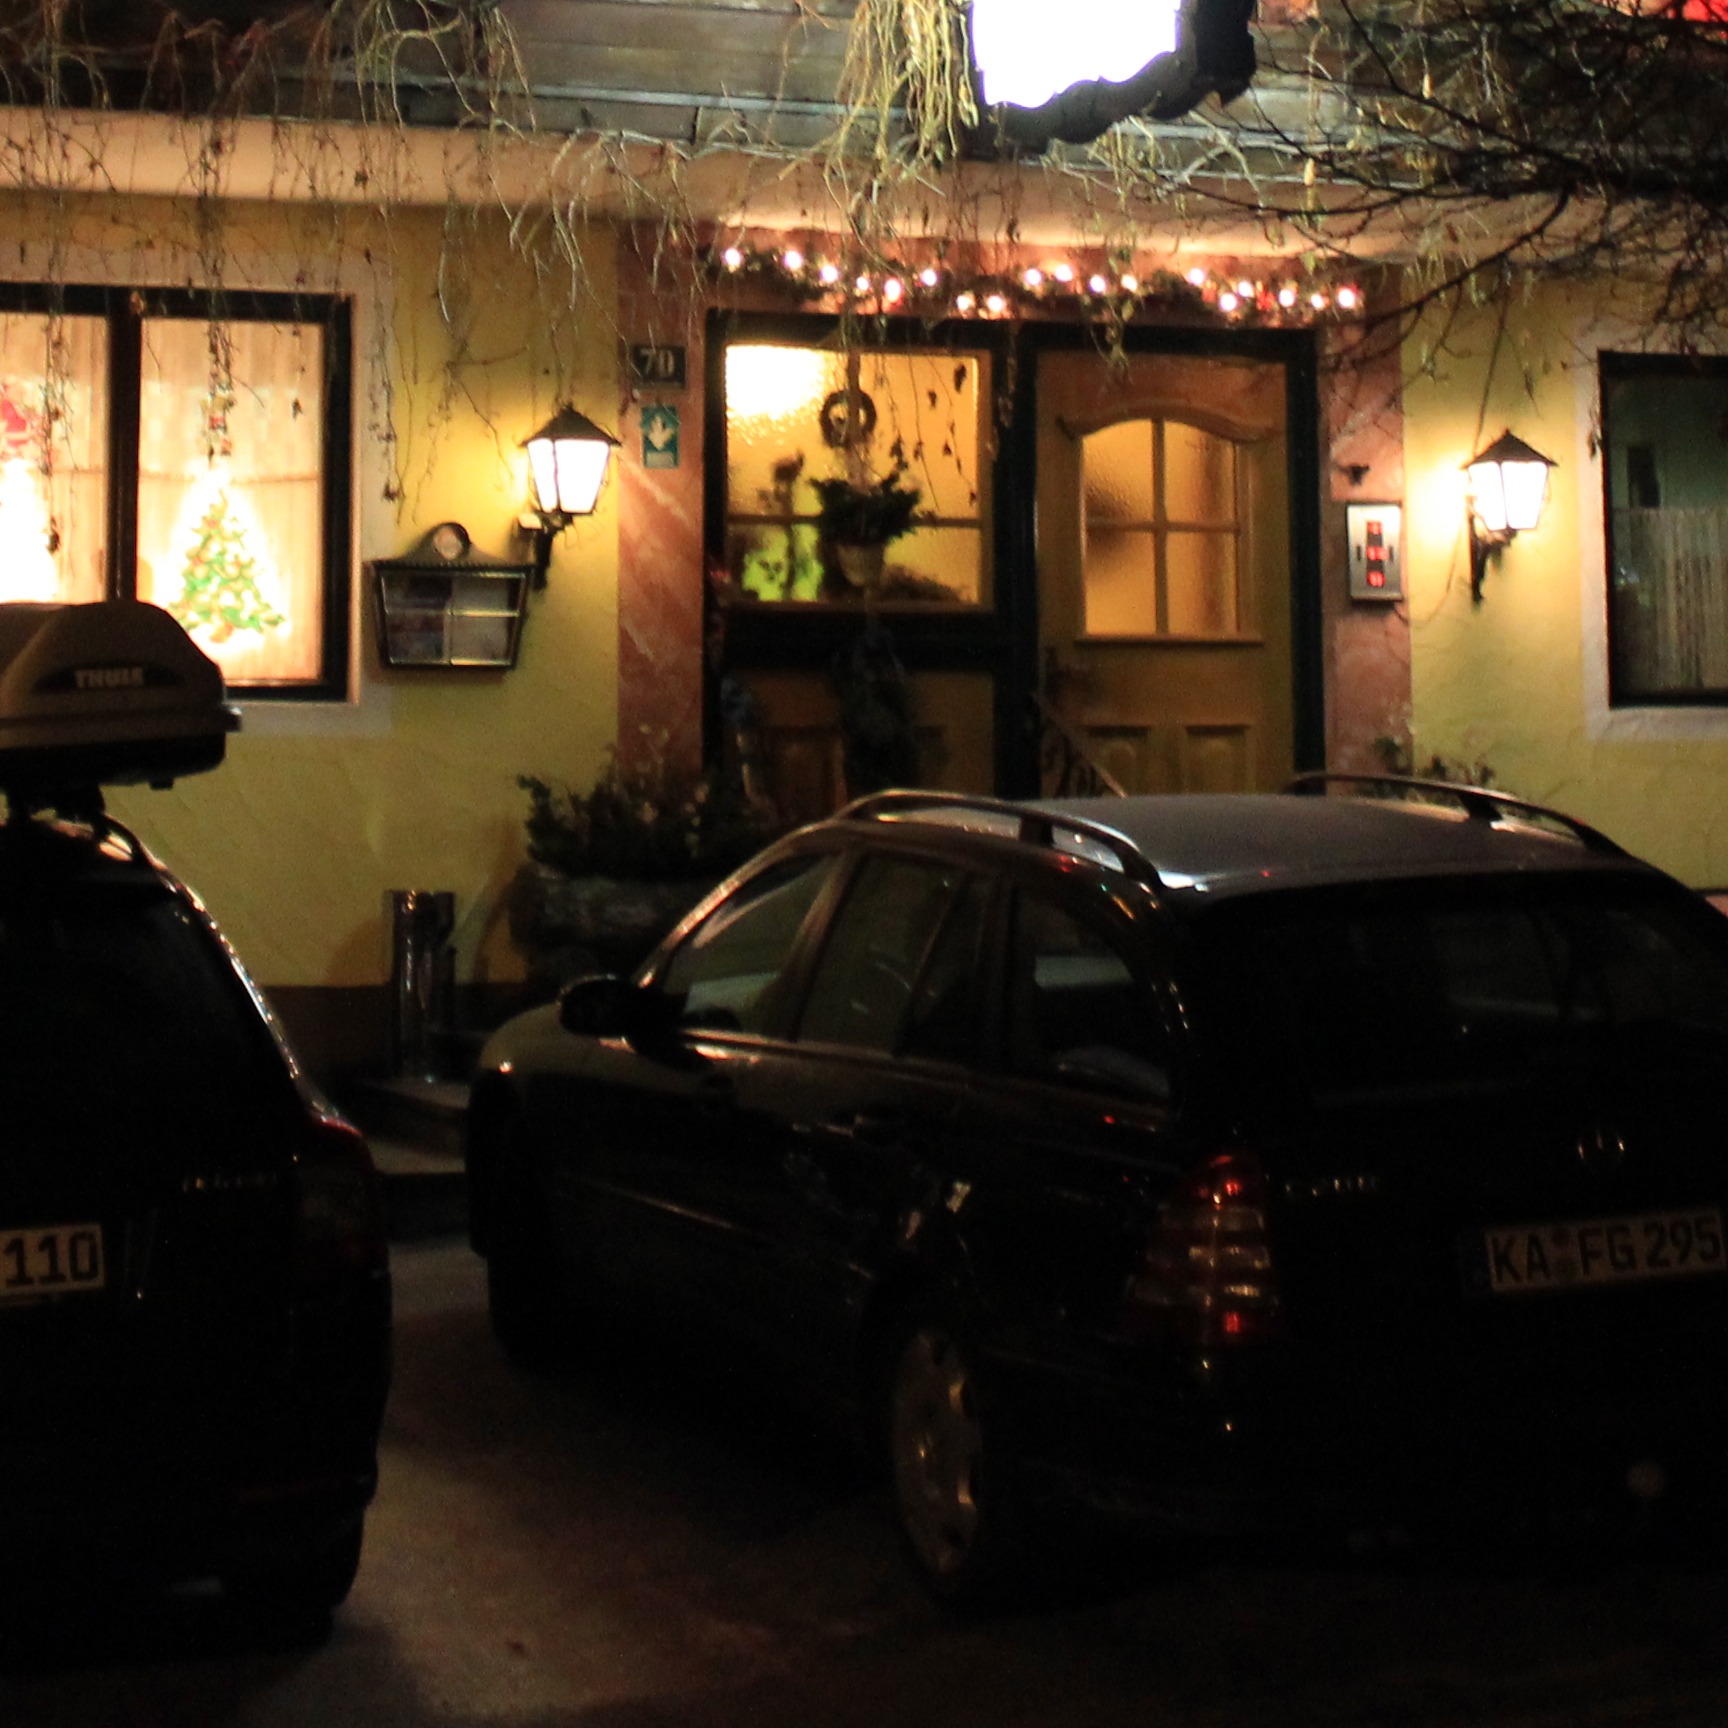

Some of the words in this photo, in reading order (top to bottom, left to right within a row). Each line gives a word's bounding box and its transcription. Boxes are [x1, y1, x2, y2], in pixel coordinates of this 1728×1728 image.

[639, 348, 675, 377] 70
[4, 1232, 97, 1284] 110
[1491, 1234, 1548, 1283] KA
[1578, 1224, 1635, 1274] FG
[1644, 1216, 1720, 1268] 295
